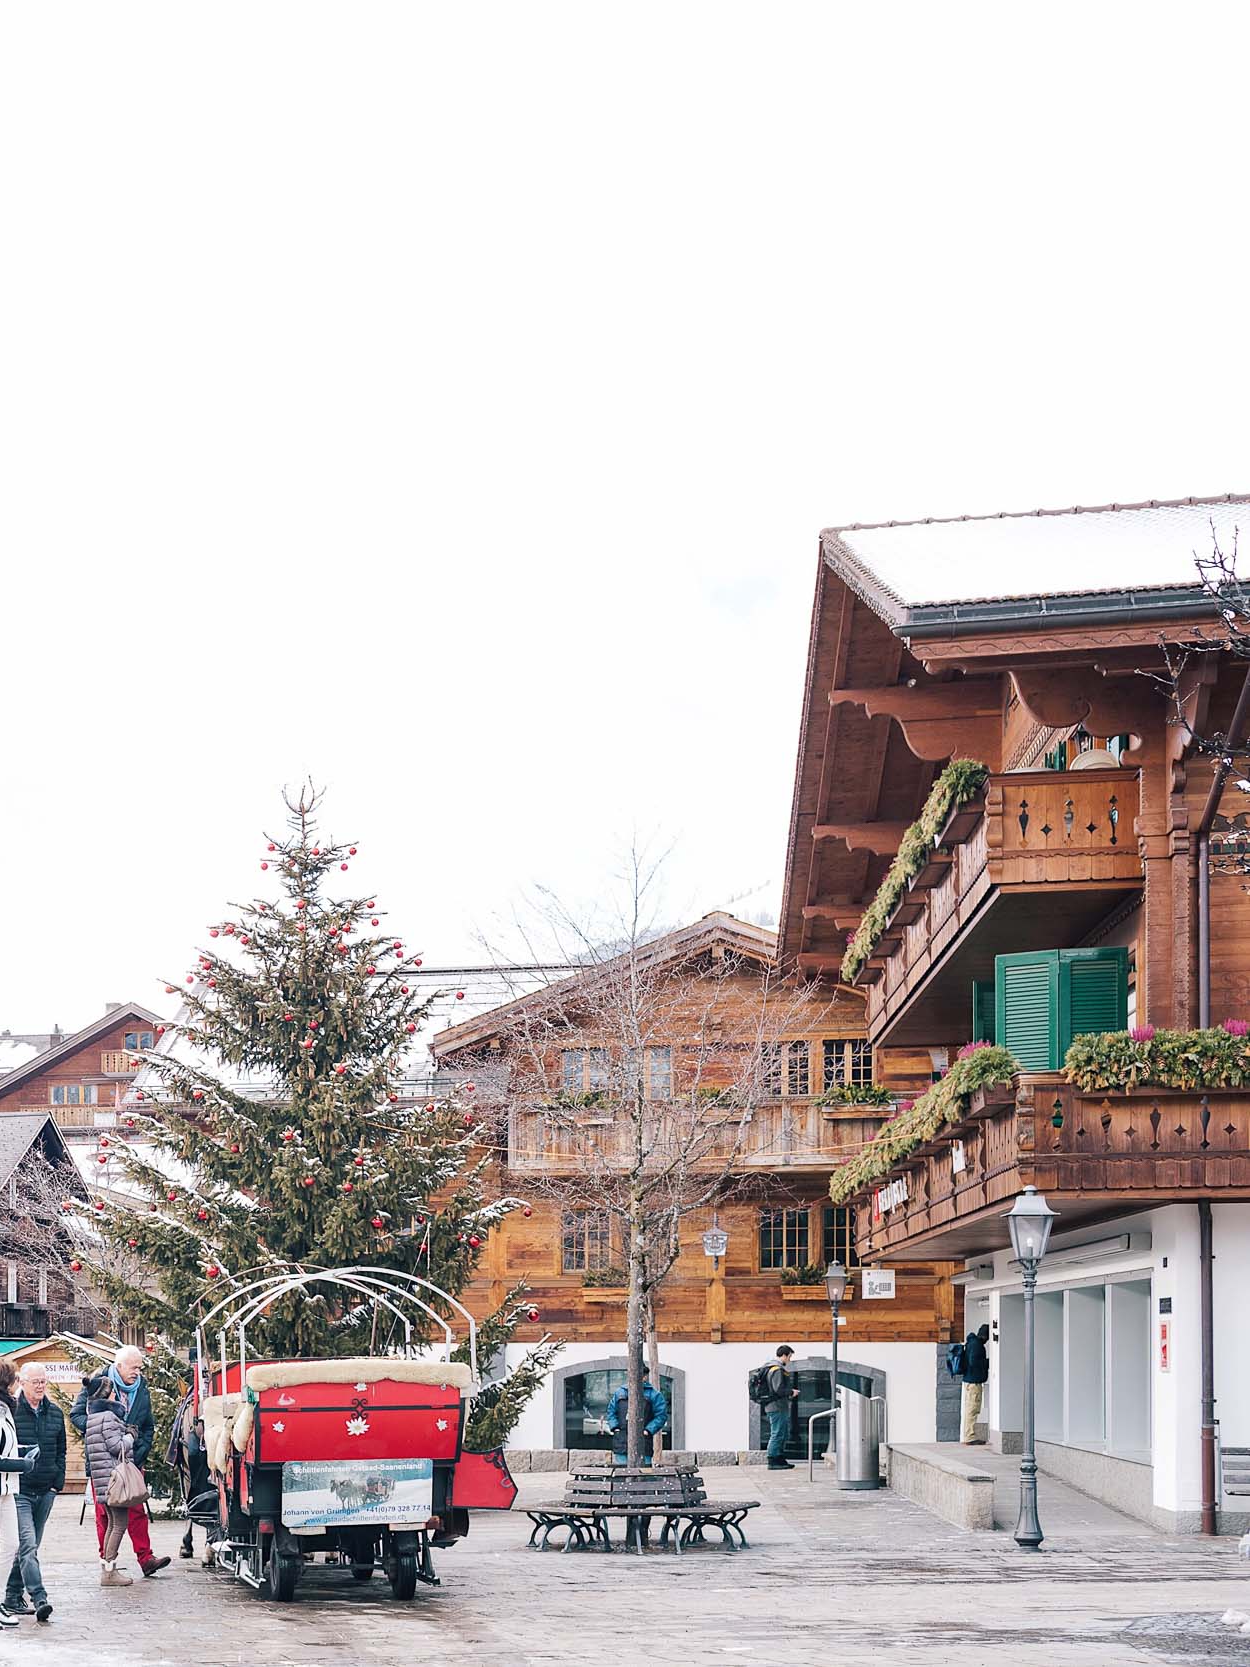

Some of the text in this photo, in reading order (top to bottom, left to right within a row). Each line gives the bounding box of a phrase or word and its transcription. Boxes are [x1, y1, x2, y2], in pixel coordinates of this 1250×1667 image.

[45, 1364, 79, 1372] SSI MARK
[351, 1463, 422, 1471] Gstaad-Saanenland
[397, 1504, 410, 1512] 328
